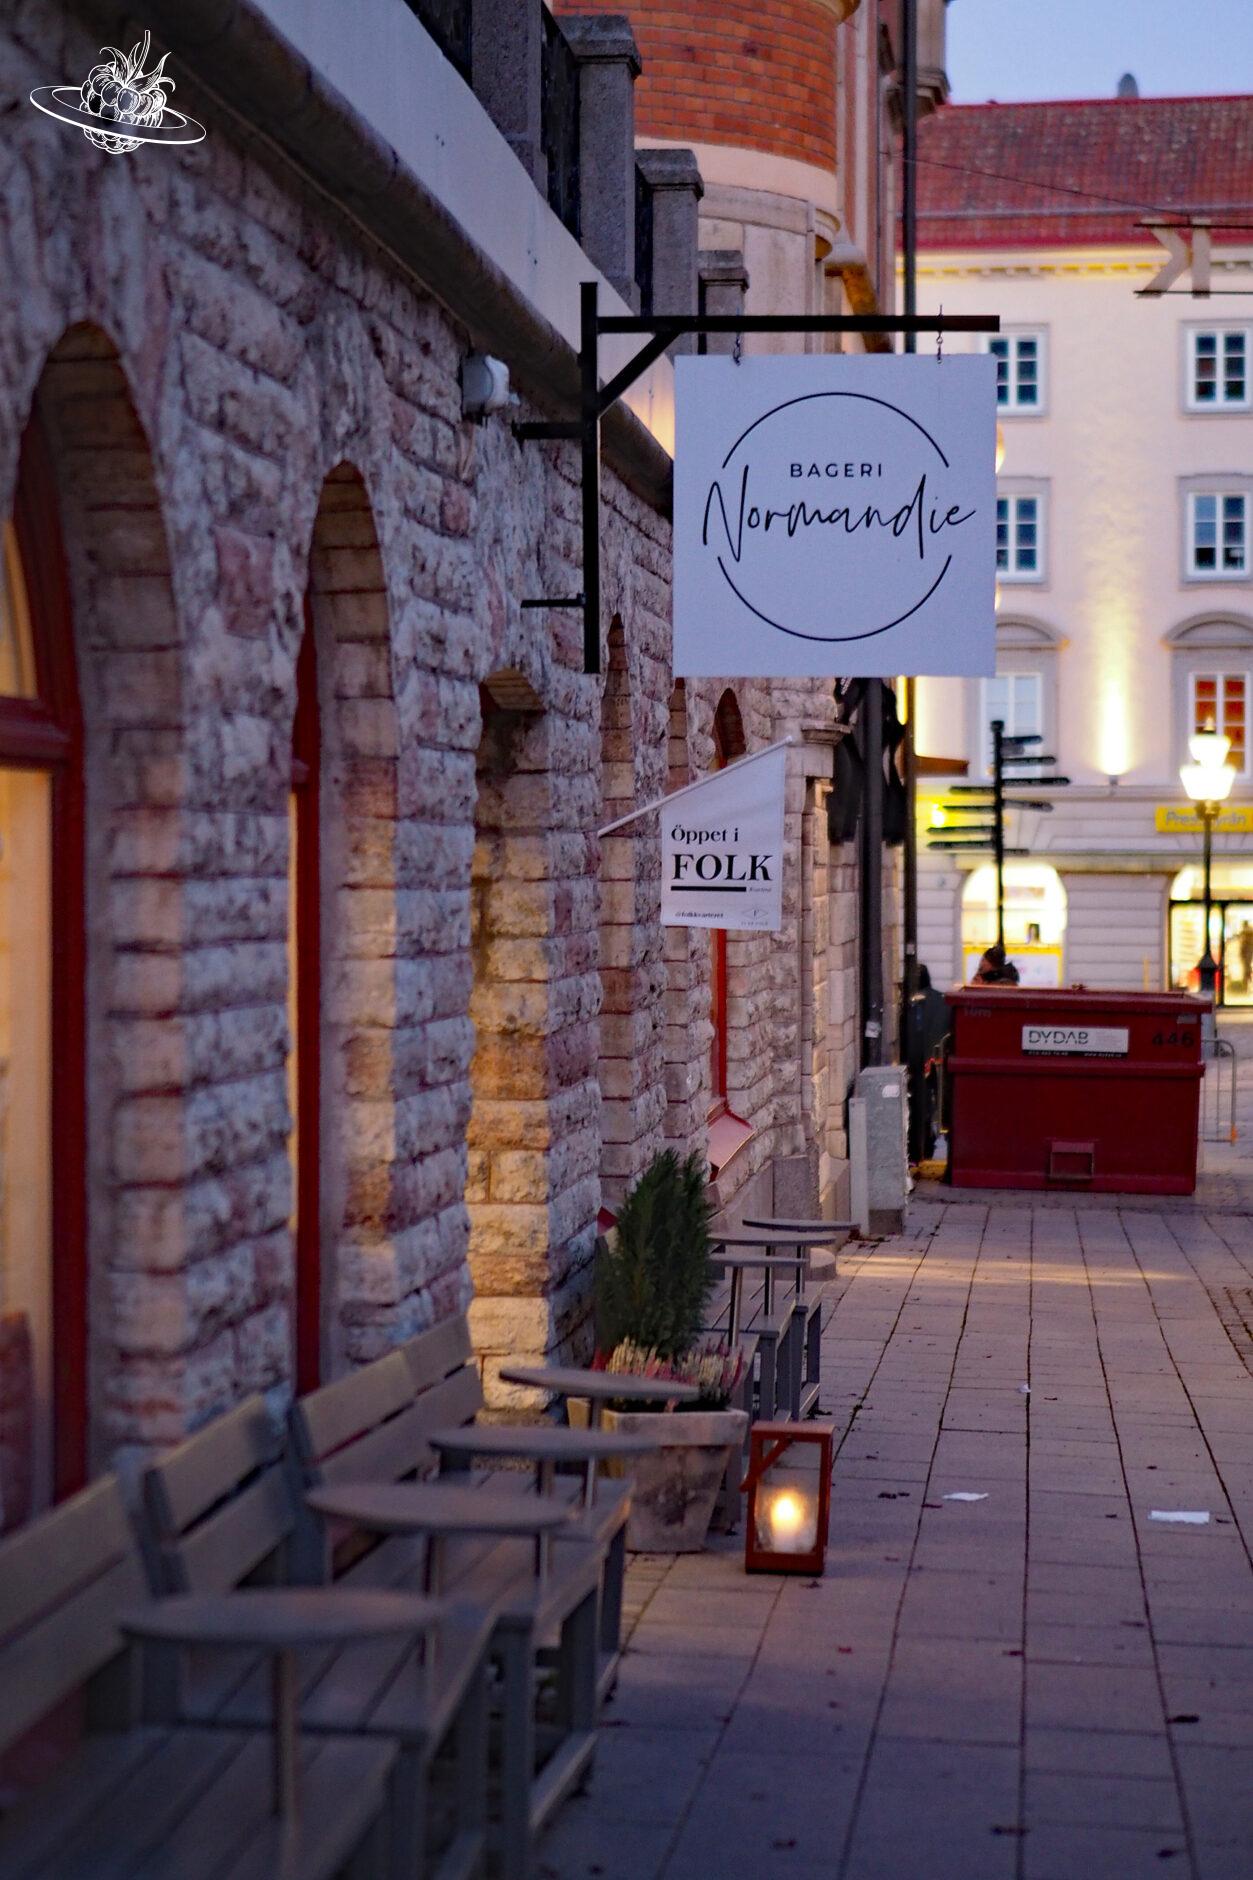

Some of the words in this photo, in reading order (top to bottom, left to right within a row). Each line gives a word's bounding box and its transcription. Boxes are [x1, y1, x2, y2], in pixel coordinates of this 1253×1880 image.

[790, 463, 883, 478] BAGERI
[703, 465, 977, 562] Normandie
[671, 824, 727, 845] Öppet
[733, 827, 739, 842] i
[671, 853, 773, 881] FOLK
[1028, 1030, 1089, 1045] DYDAB
